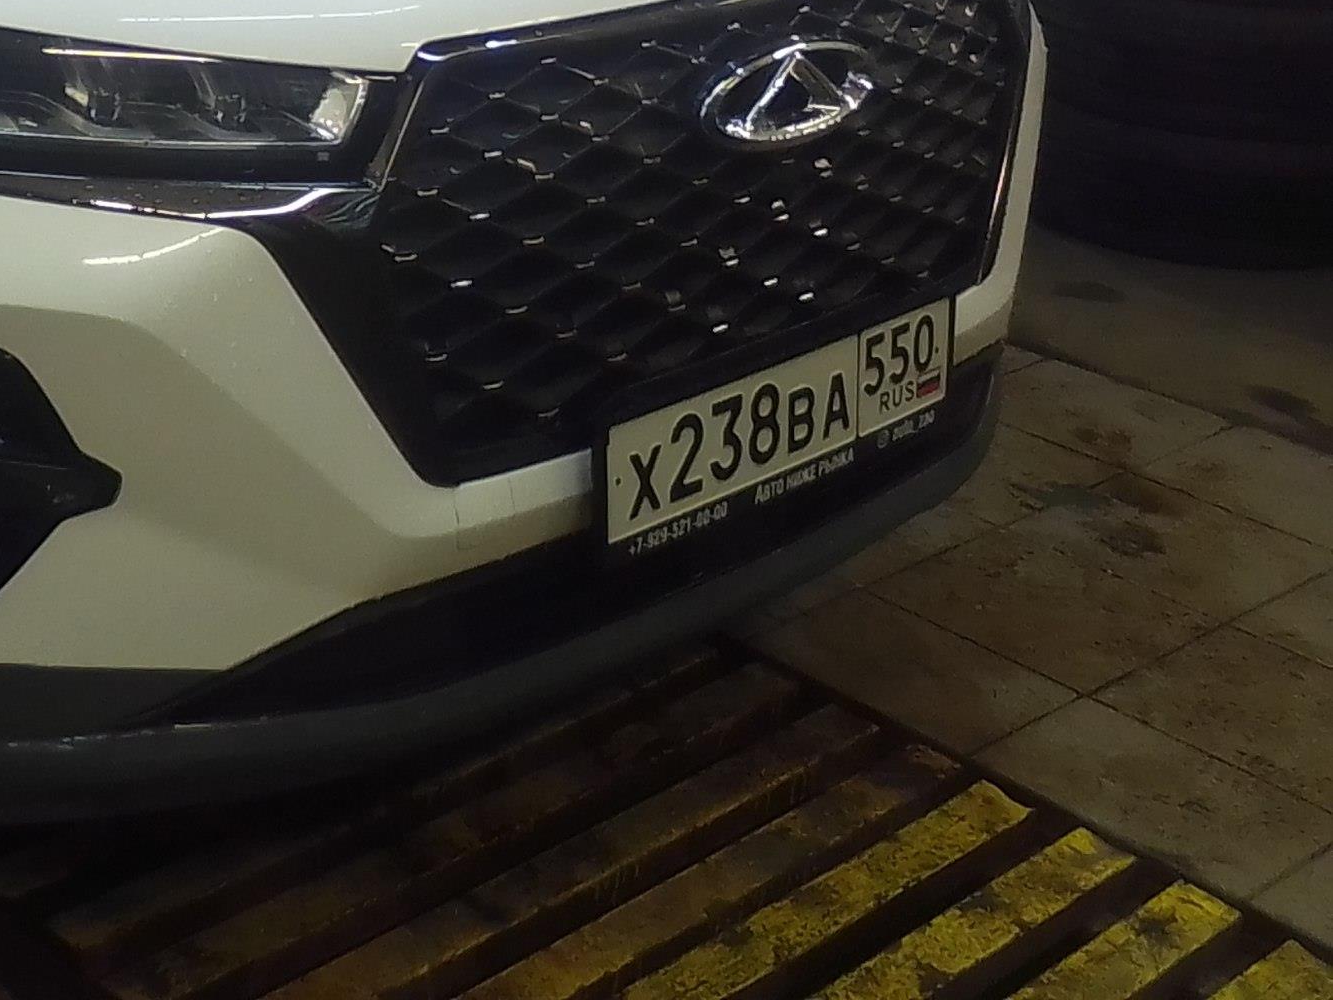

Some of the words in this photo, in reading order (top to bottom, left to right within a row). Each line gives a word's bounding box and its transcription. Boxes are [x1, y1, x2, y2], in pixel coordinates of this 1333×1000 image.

[628, 372, 850, 521] Х238ВА
[864, 314, 935, 396] 550
[878, 380, 915, 414] RUS
